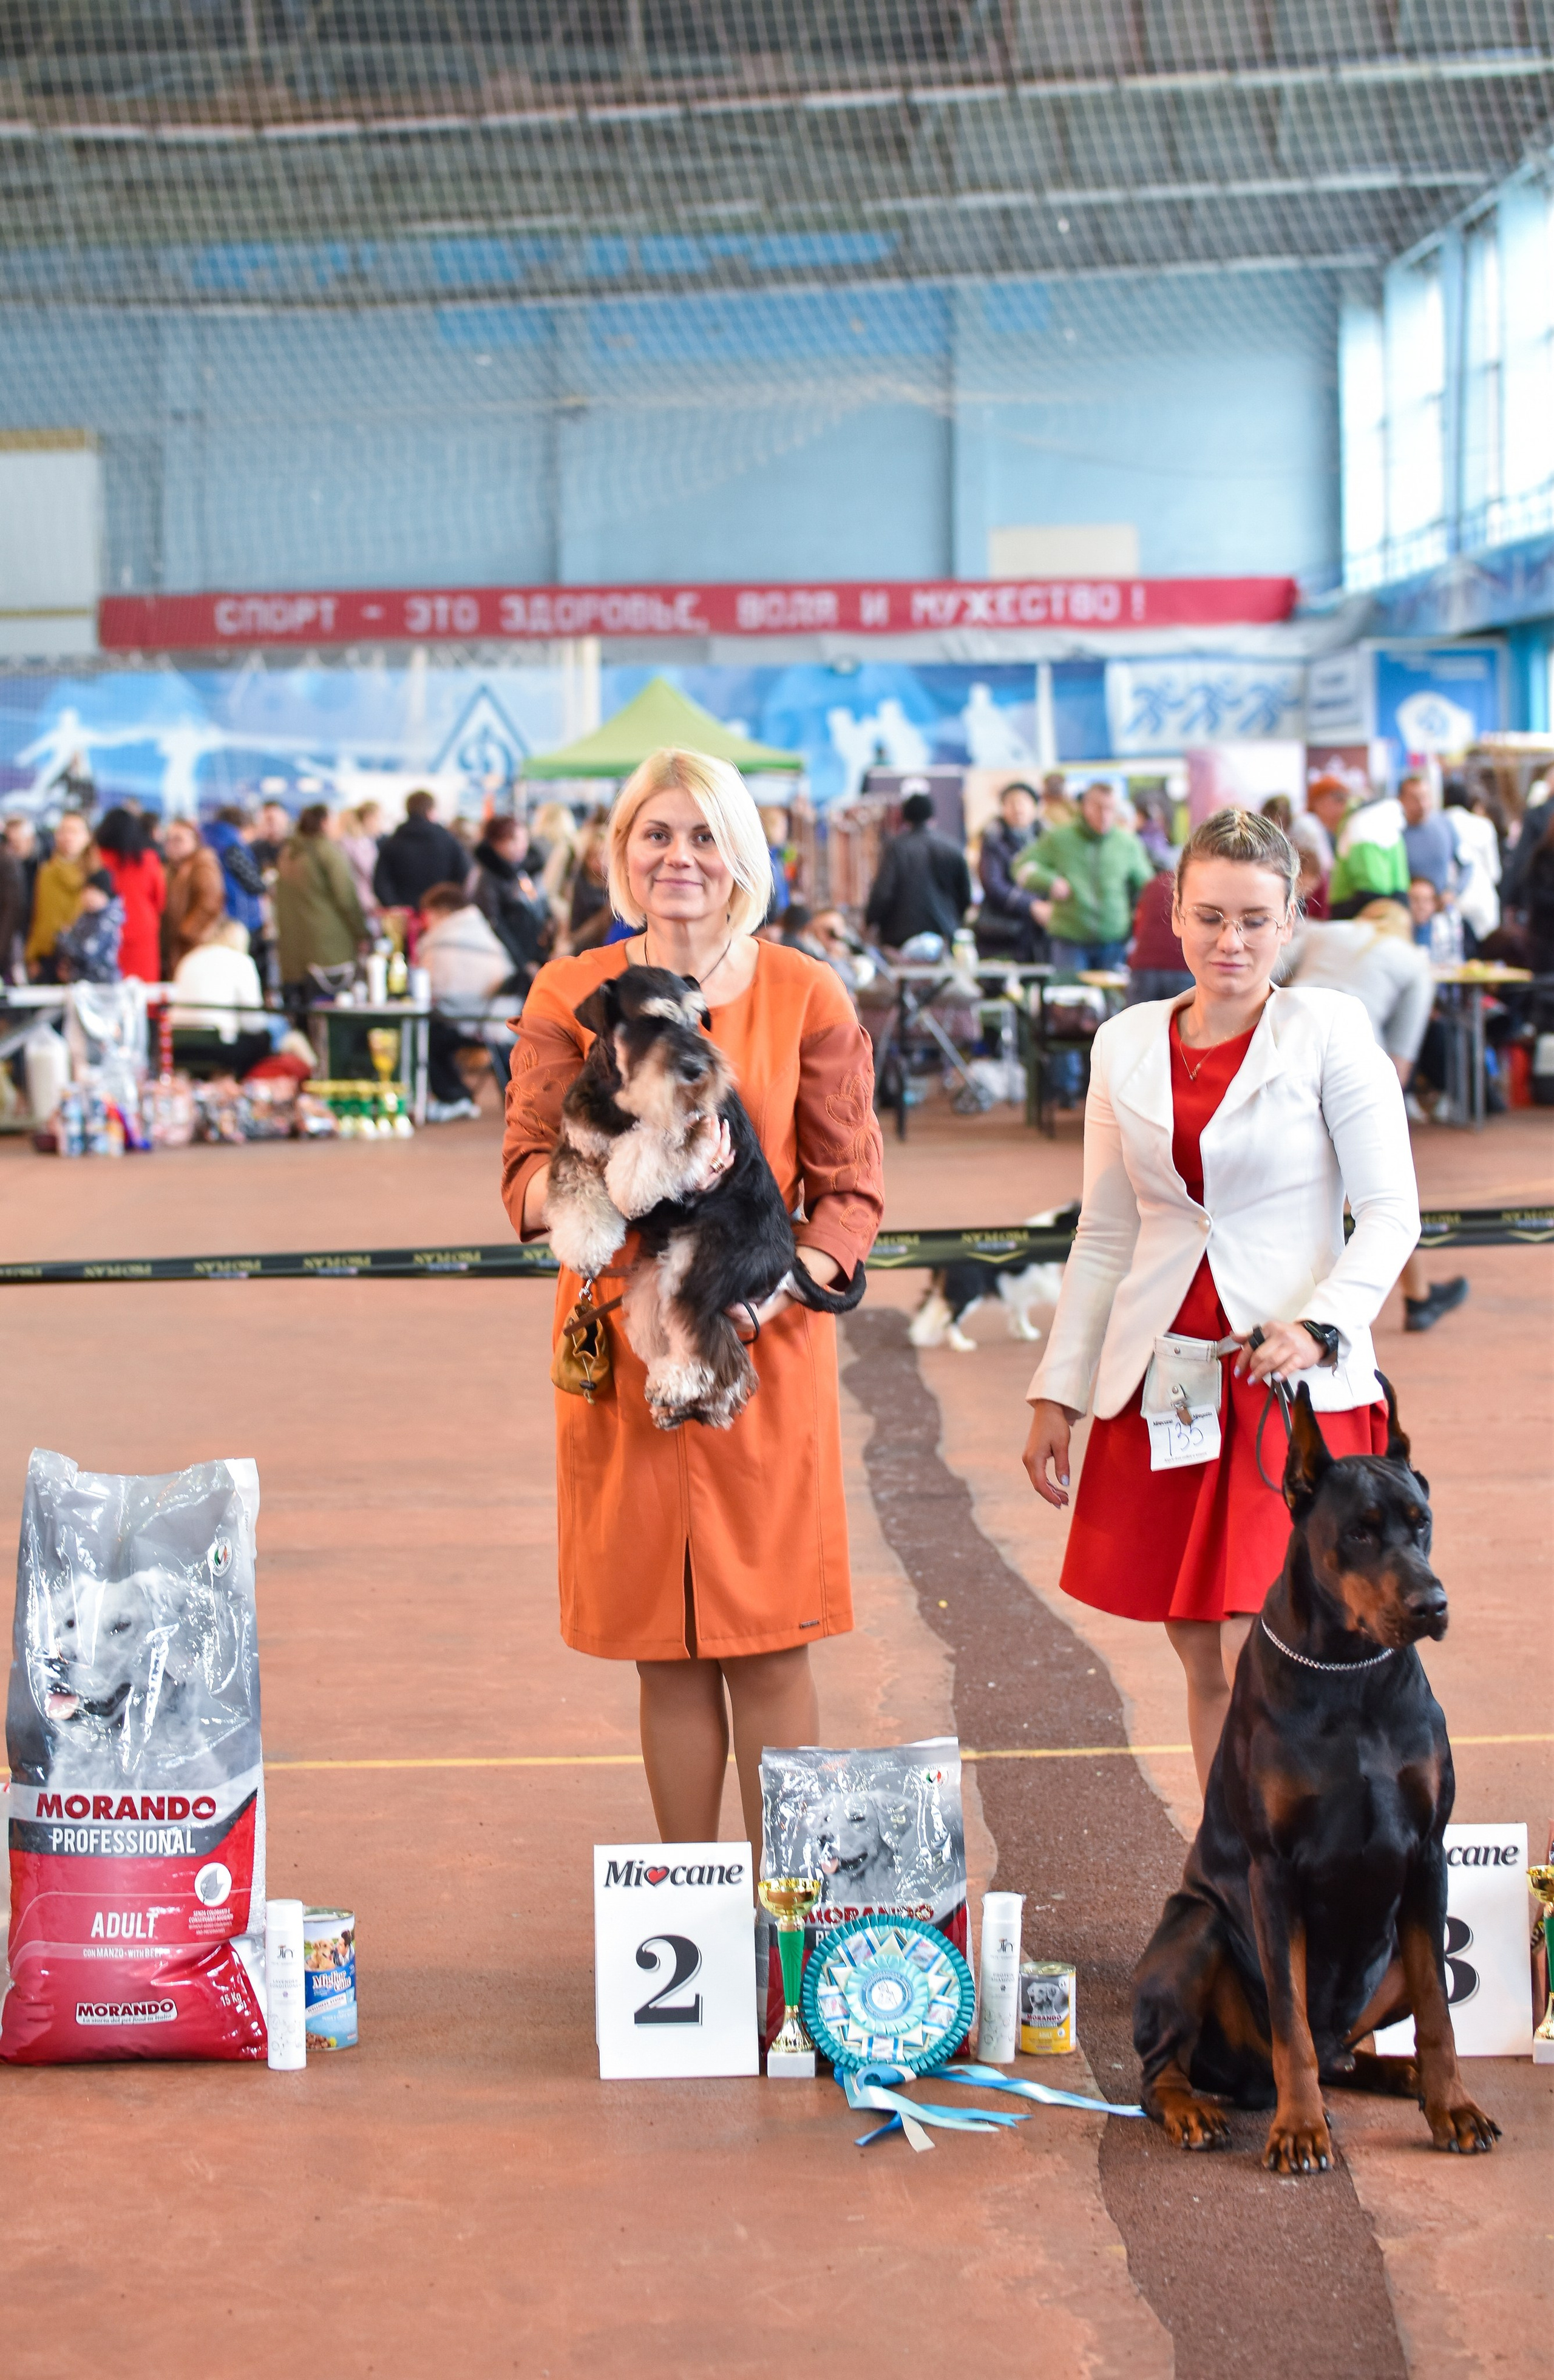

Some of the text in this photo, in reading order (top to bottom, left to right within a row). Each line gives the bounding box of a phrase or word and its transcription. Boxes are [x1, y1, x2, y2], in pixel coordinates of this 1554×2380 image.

[214, 597, 338, 634] СПОРТ
[404, 595, 480, 633] ЭТО
[498, 591, 709, 634] ЗДОРОВЬЕ,
[736, 589, 839, 629] ВОЛЯ
[860, 589, 891, 627] И
[912, 584, 1121, 625] МУЖЕСТВО
[1167, 1417, 1204, 1456] 135
[36, 1792, 217, 1820] MORANDO
[52, 1828, 196, 1854] PROFESSIONAL
[1447, 1845, 1519, 1866] cane
[90, 1911, 158, 1939] ADULT
[83, 1948, 96, 1958] CON
[96, 1948, 124, 1958] MANZO
[127, 1949, 144, 1959] WITH
[313, 1970, 346, 1988] Miglior
[634, 1934, 703, 2026] 2
[78, 2002, 174, 2016] MORANDO
[220, 1993, 231, 2007] 15
